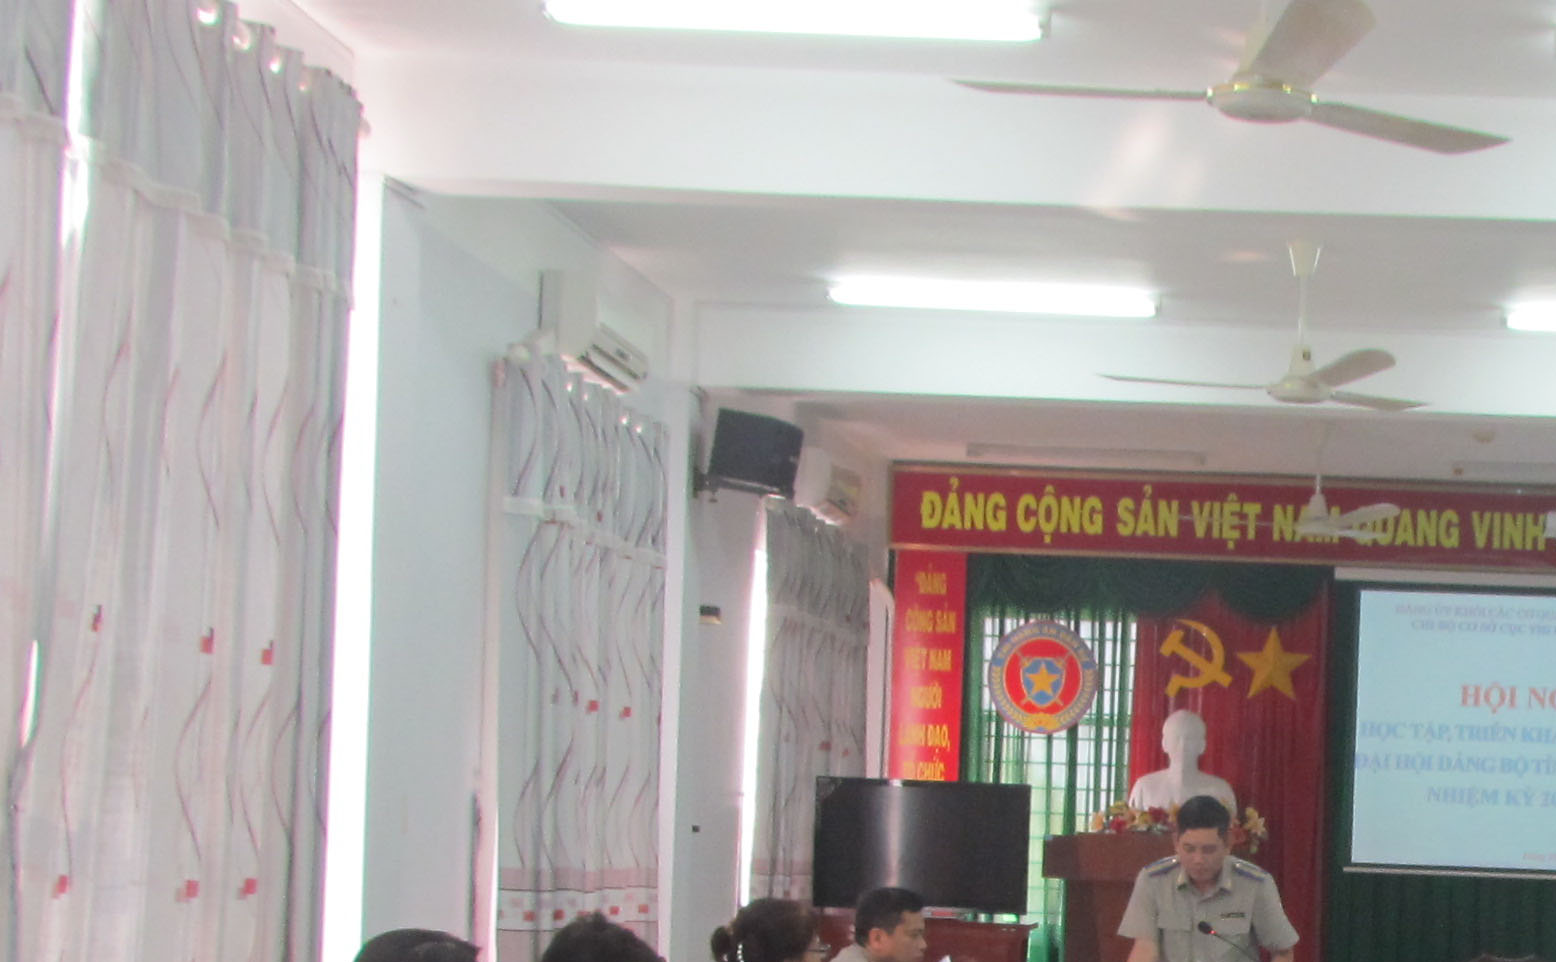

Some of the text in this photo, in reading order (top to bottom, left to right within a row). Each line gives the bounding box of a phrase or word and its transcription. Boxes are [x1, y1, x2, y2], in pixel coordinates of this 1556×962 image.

[920, 476, 1007, 532] ĐẢNG
[1026, 485, 1103, 544] CỘNG
[1116, 484, 1179, 538] SẢN
[1191, 492, 1262, 549] VIỆT
[1471, 510, 1546, 553] VINH
[1460, 681, 1518, 715] HỘI
